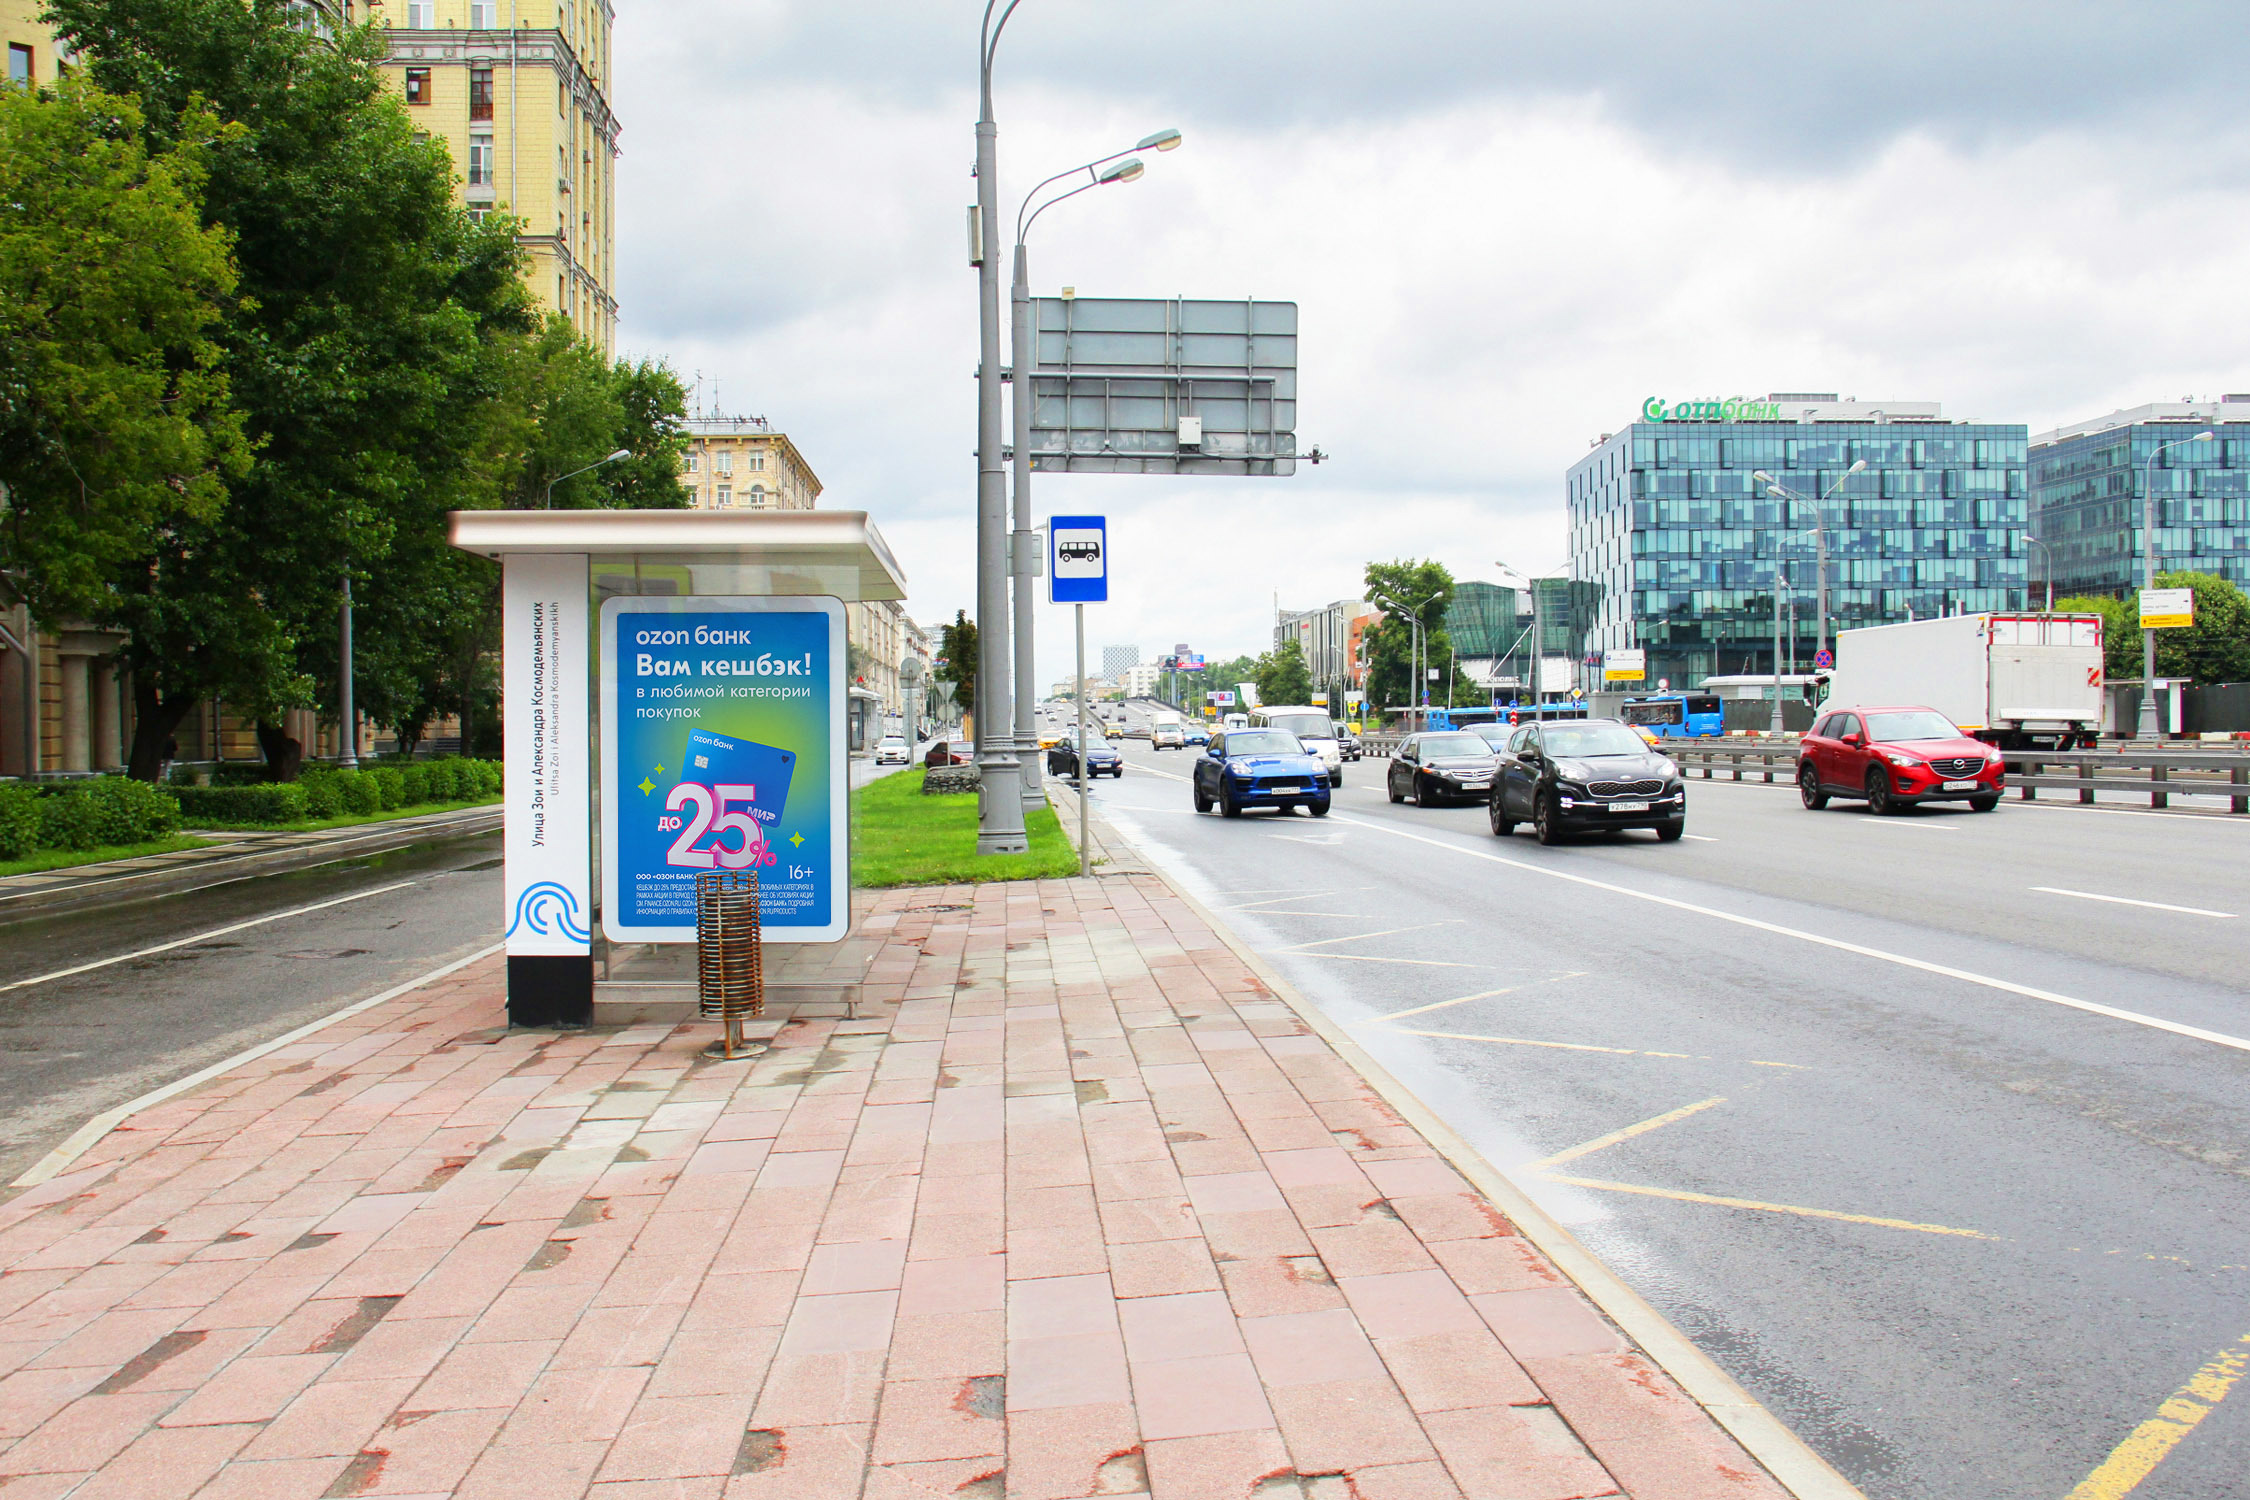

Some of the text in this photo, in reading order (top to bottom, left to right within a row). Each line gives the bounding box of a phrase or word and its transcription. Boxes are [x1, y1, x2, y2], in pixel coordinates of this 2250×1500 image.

[635, 625, 752, 645] ozon банк
[531, 602, 545, 706] Космодемьянских
[550, 602, 560, 692] Kosmodemyanskikh
[636, 652, 812, 676] Вам кешбэк!
[636, 683, 811, 701] в любимой категории
[550, 694, 559, 744] Aleksandra
[636, 707, 701, 721] покупок
[531, 709, 546, 776] Александра
[693, 735, 734, 751] ozon банк
[550, 752, 559, 767] Zoi
[550, 769, 559, 796] Ulitsa
[531, 789, 544, 810] Зои
[531, 813, 545, 848] Улица
[789, 865, 814, 879] 16+
